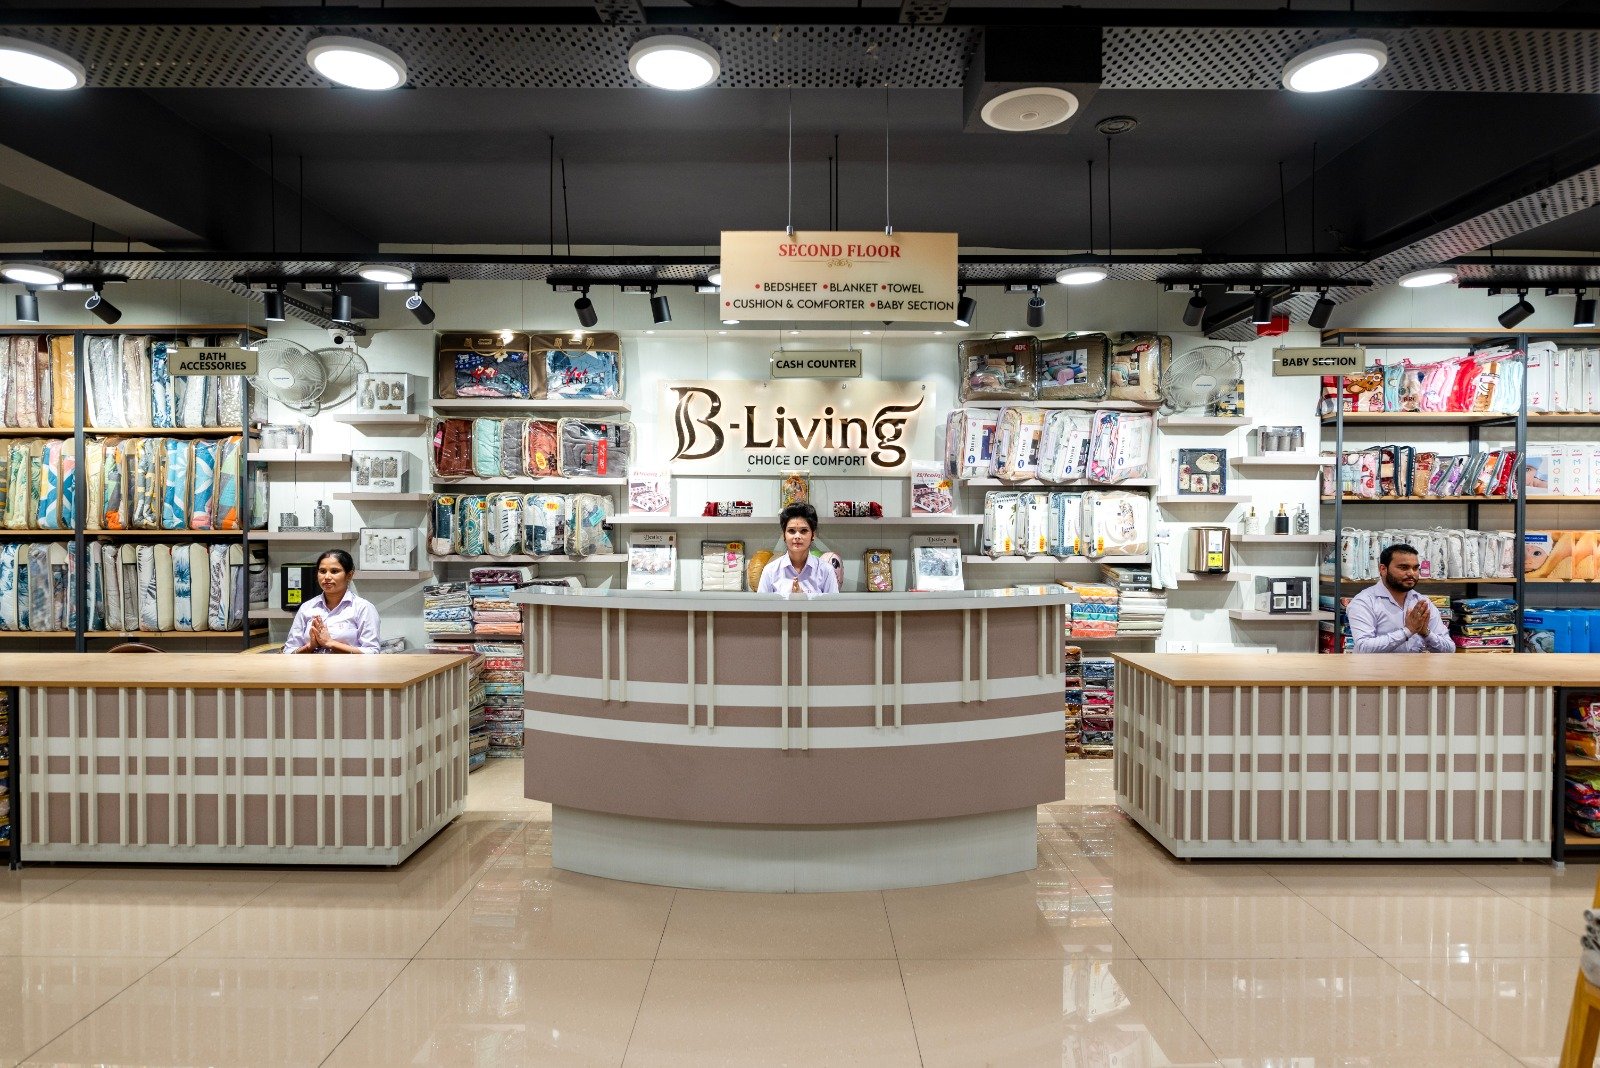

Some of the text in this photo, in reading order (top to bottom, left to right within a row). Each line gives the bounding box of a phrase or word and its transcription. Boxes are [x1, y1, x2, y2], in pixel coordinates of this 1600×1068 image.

[778, 243, 901, 258] SECOND FLOOR
[763, 282, 924, 294] BEDSHEET BLANKET TOWEL
[733, 299, 954, 311] CUSHION & COMFORTER BABY SECTION
[199, 352, 227, 361] BATH
[1282, 357, 1356, 367] BABY SECTION
[179, 361, 247, 370] ACCESSORIES
[776, 359, 857, 369] CASH COUNTER
[670, 386, 925, 468] B-Living
[747, 454, 867, 466] CHOICE OF COMFORT
